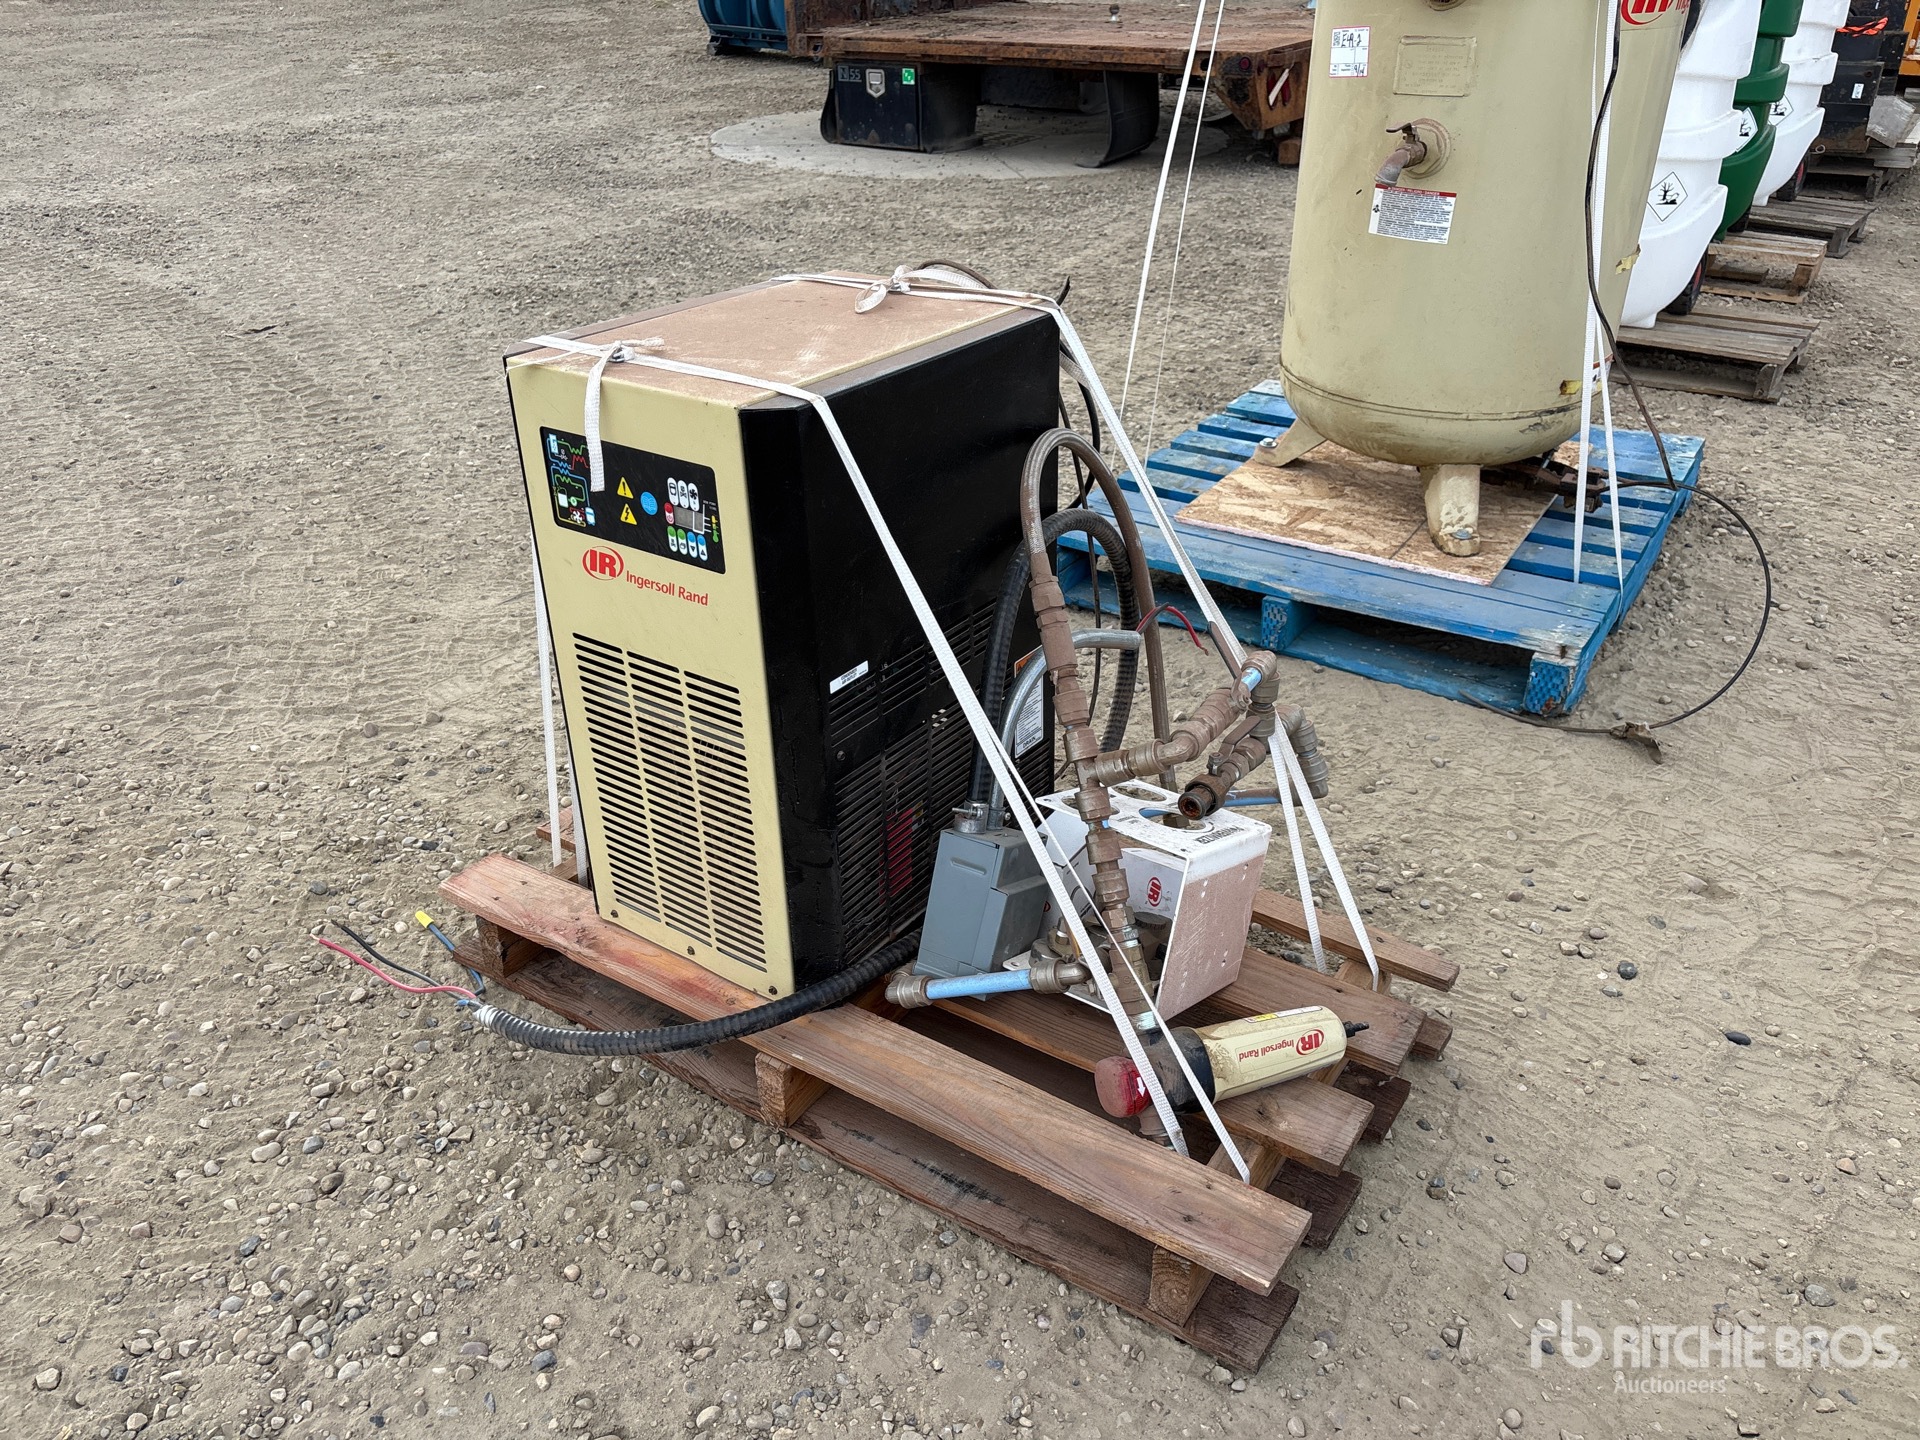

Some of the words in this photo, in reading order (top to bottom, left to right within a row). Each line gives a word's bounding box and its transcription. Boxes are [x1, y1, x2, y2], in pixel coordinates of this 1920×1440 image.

[589, 549, 617, 578] IR
[626, 570, 675, 596] Ingersoll
[678, 586, 709, 606] Rand
[1148, 881, 1162, 902] IR
[1260, 1039, 1295, 1057] Ingersoll
[1300, 1032, 1320, 1052] IR
[1239, 1049, 1260, 1062] Rand
